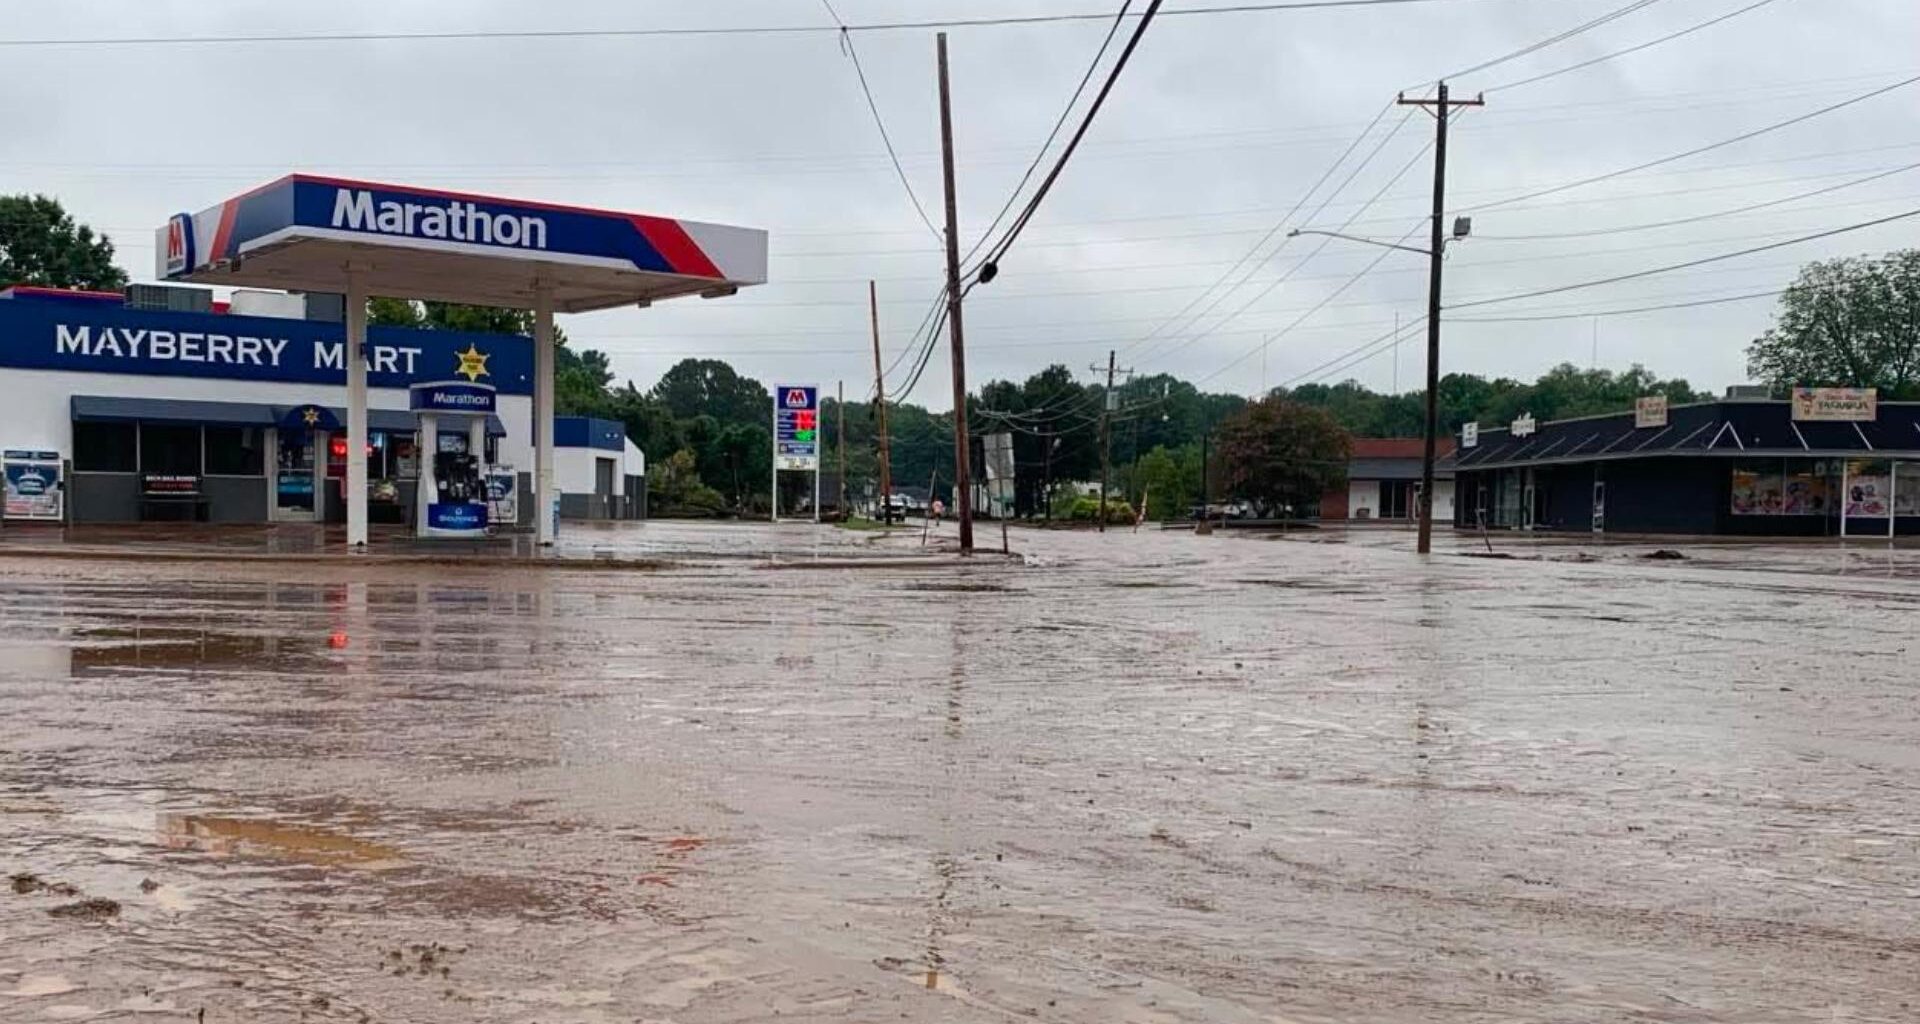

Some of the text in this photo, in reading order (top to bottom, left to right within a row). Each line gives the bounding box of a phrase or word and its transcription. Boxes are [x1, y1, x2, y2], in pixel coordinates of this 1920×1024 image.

[332, 188, 546, 248] Marathon
[56, 324, 422, 374] MAYBERRY MRT
[433, 392, 489, 405] Marathon
